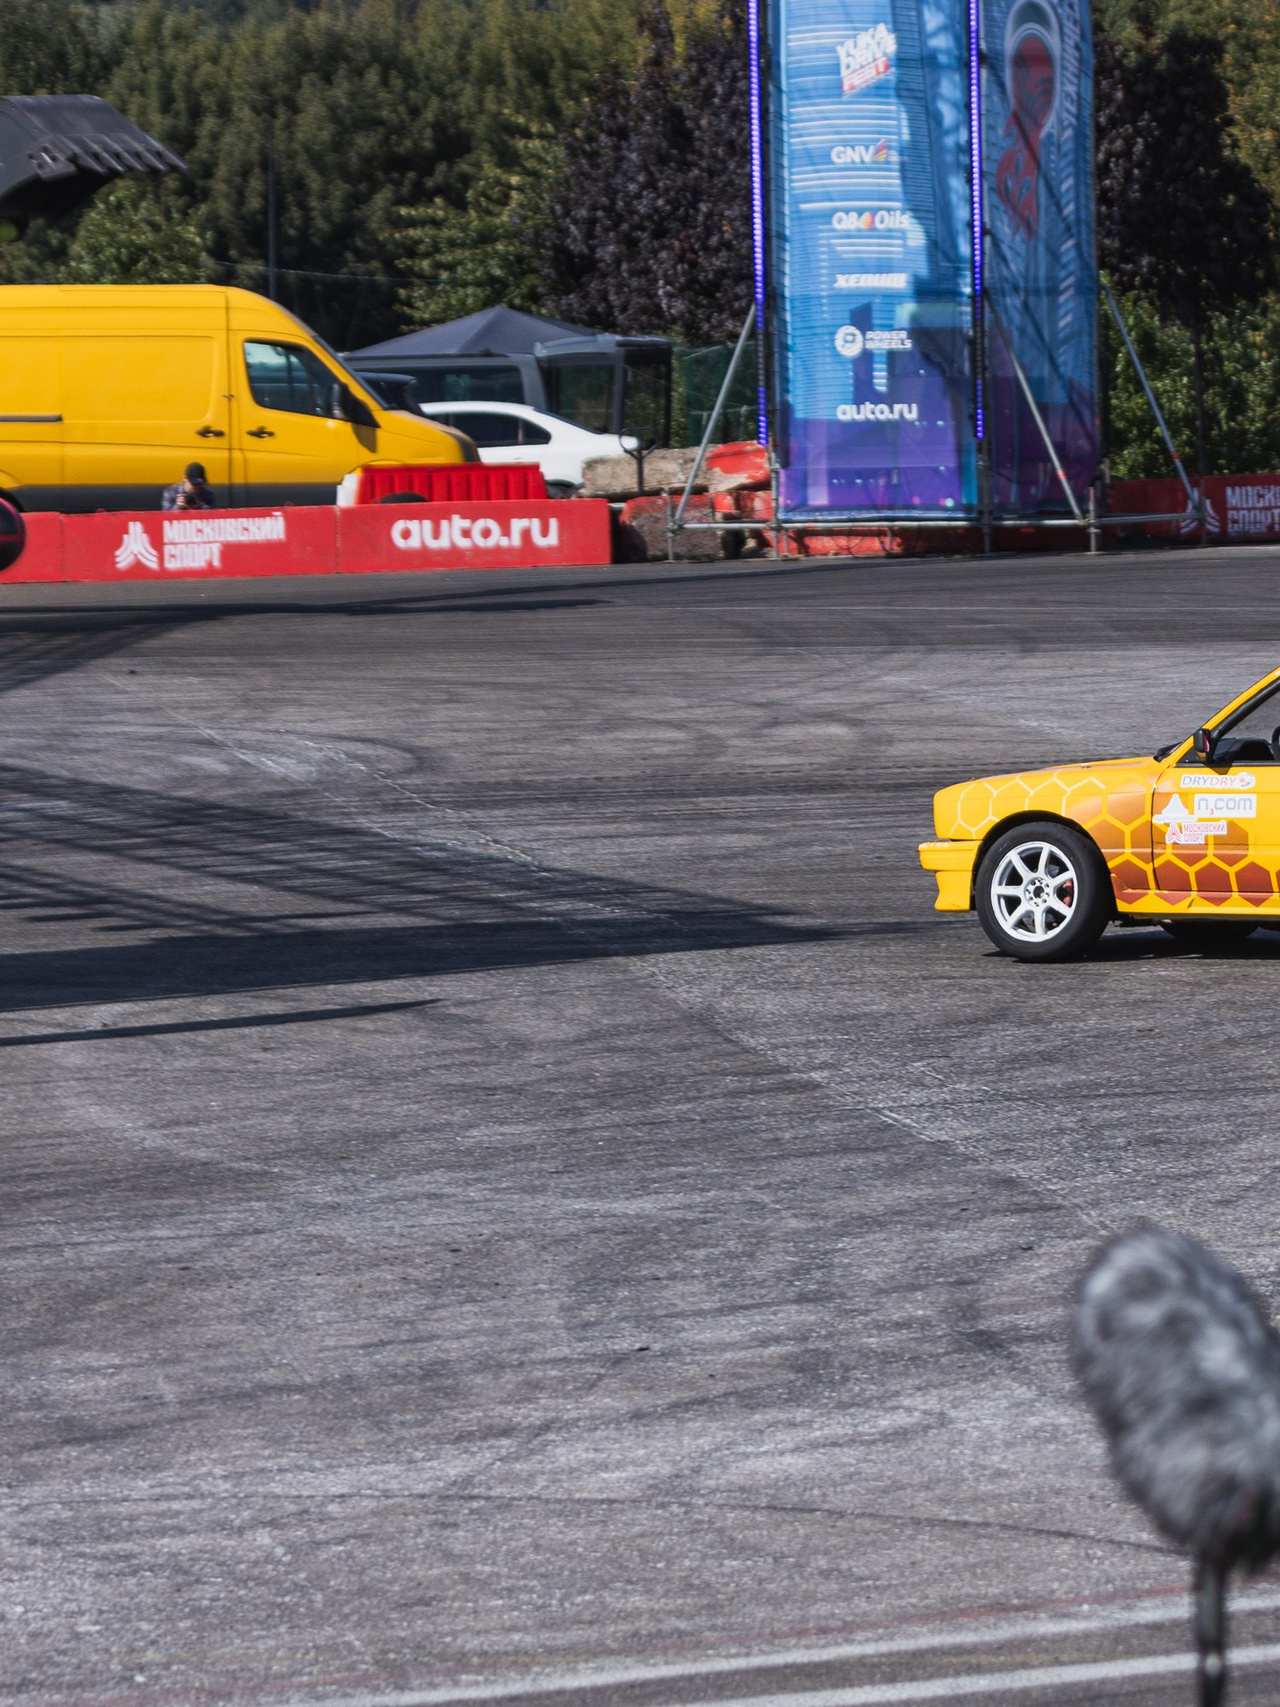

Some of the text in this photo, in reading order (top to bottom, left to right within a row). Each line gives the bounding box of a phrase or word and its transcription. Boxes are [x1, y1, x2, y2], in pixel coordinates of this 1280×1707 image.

[831, 145, 875, 163] GNV
[832, 210, 910, 230] Q8 Oils
[865, 340, 912, 349] WHEELS
[836, 402, 918, 421] auto.ru
[163, 511, 286, 543] МОСКОВСКИЙ
[1226, 507, 1280, 534] СПОРТ
[391, 514, 560, 549] auto.ru
[163, 542, 222, 570] СПОРТ
[1182, 775, 1236, 786] DRYDRY
